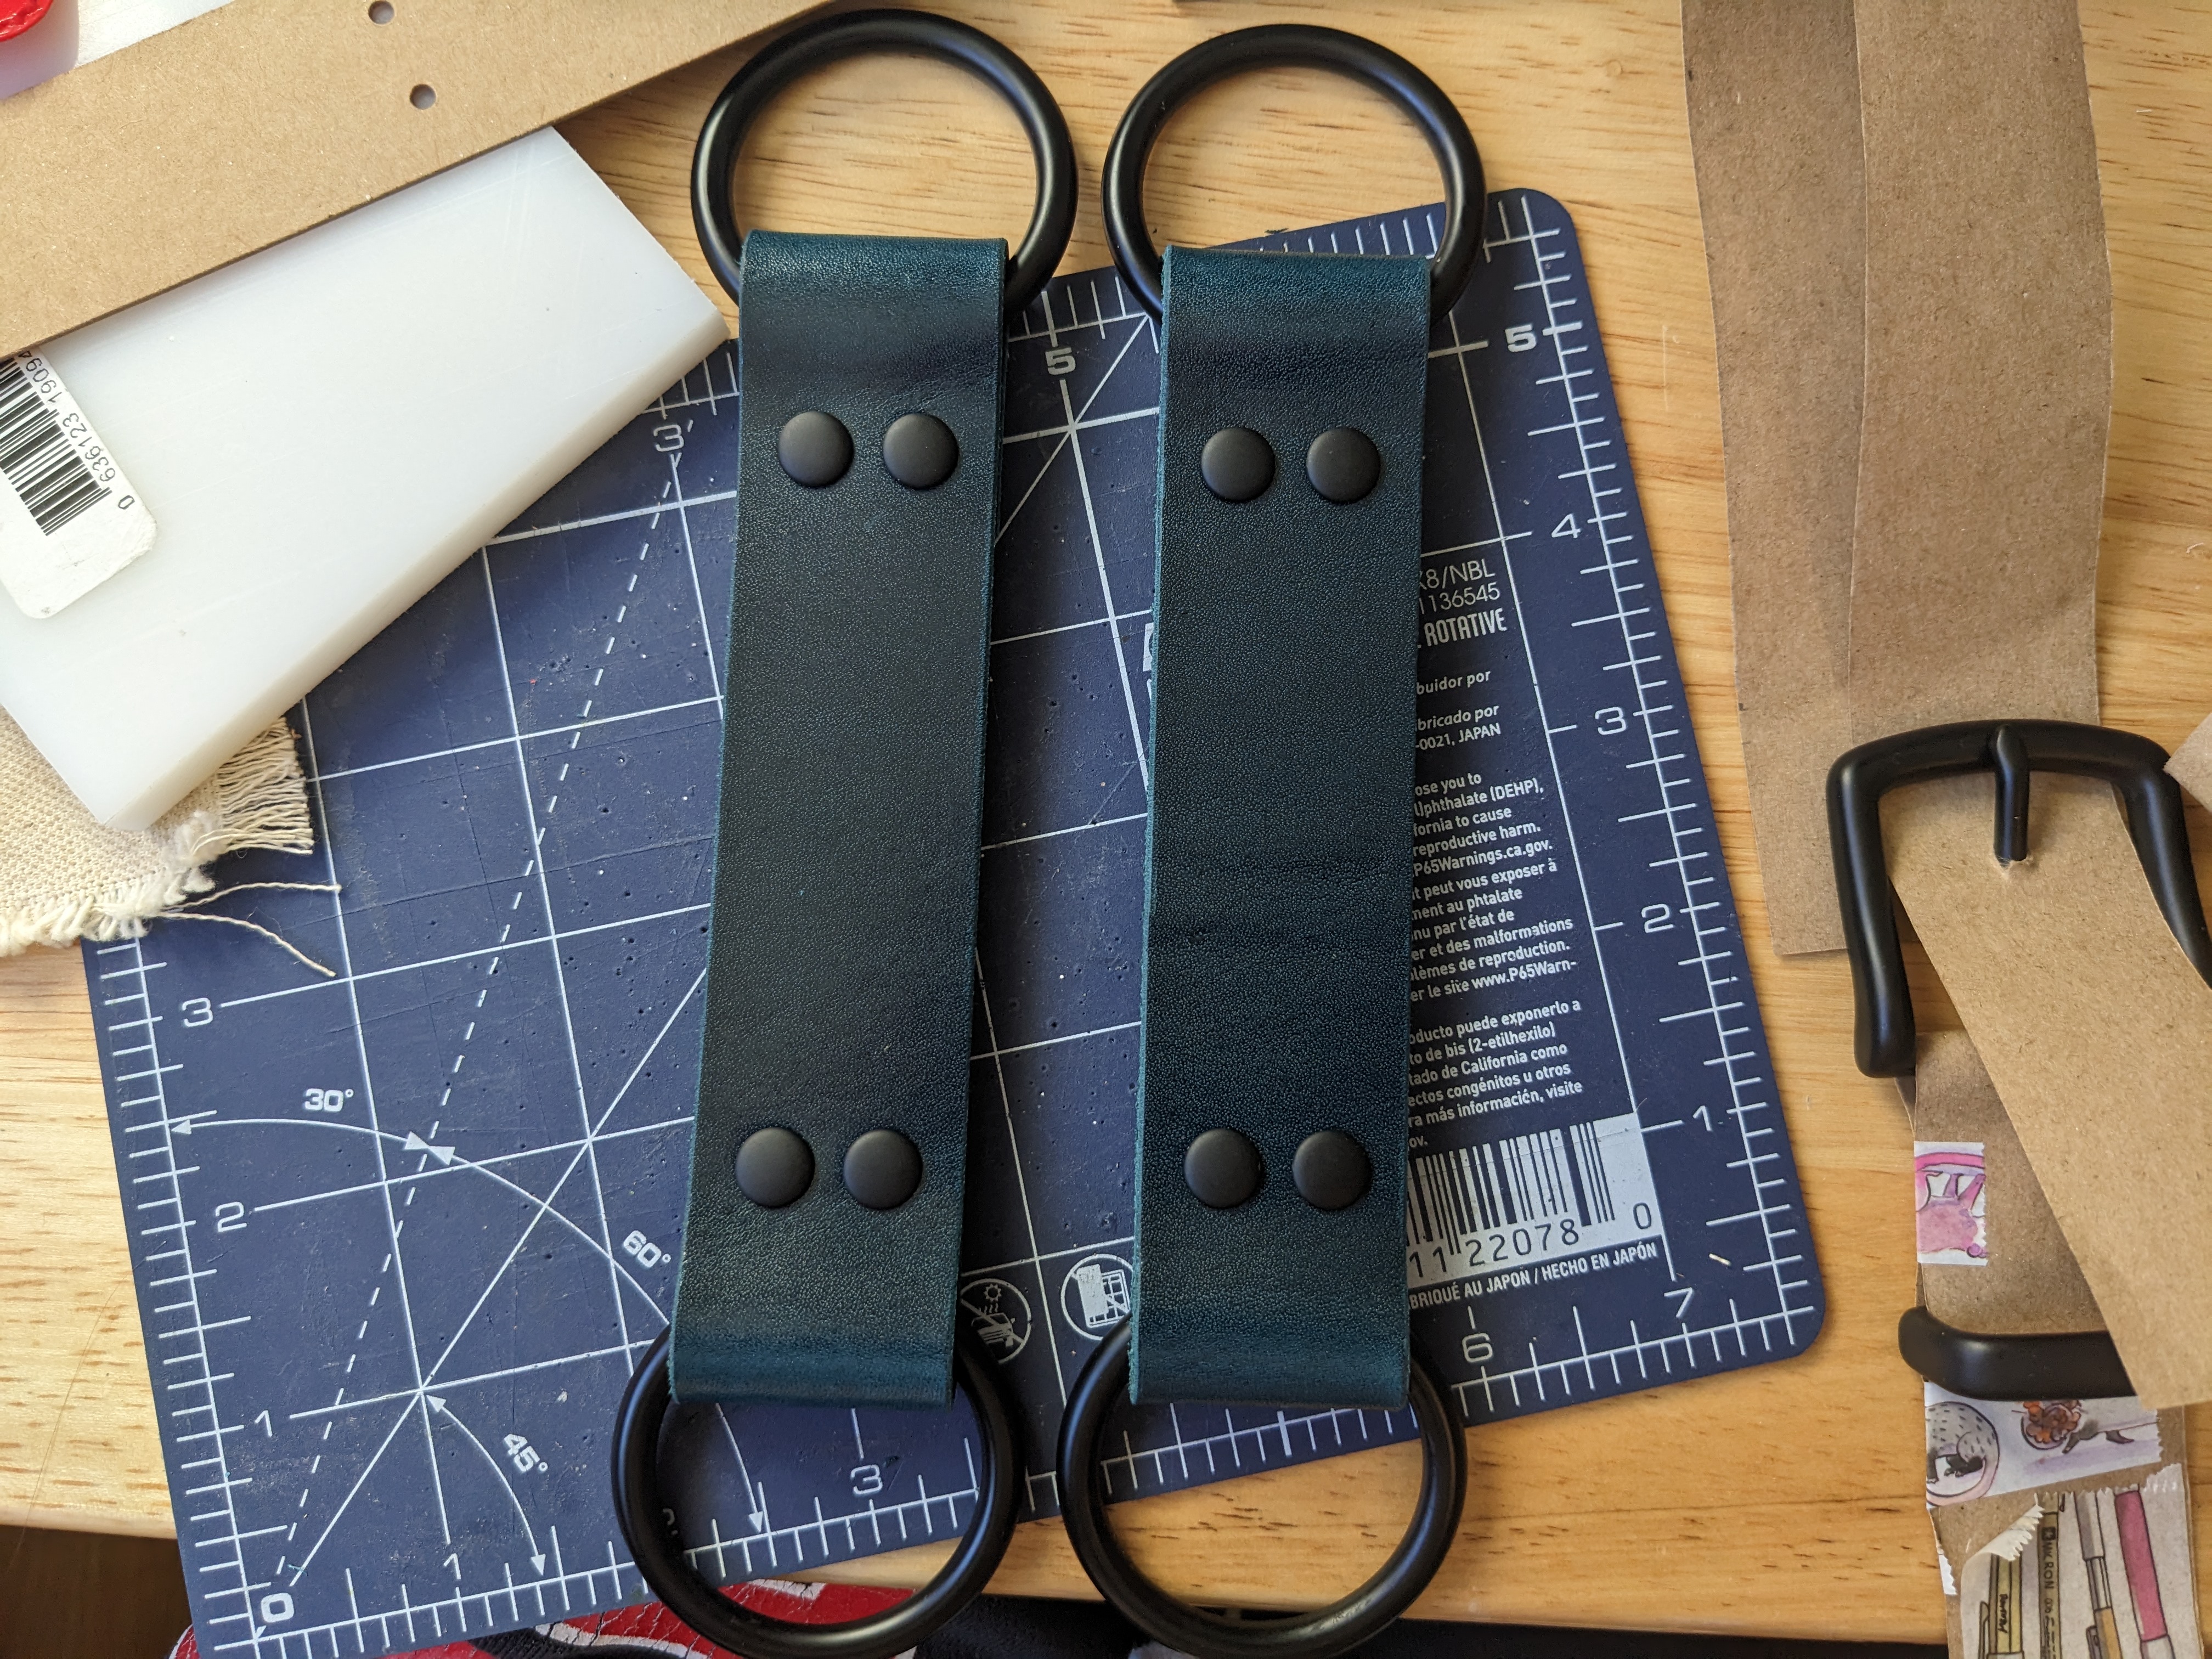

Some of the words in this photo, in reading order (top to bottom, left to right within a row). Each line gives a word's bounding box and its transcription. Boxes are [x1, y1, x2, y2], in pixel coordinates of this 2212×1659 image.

[1505, 325, 1537, 352] 5
[1045, 347, 1076, 375] 5
[63, 413, 116, 482] 636123
[1551, 514, 1581, 538] 4
[1424, 608, 1508, 646] ROTATIVE
[1467, 671, 1491, 687] por
[1415, 710, 1471, 731] bricado
[1475, 706, 1499, 723] por
[1459, 723, 1502, 742] JAPAN
[1595, 707, 1627, 736] 3
[1415, 783, 1438, 795] ose
[1441, 777, 1465, 794] you
[1468, 773, 1481, 785] to
[1490, 777, 1544, 801] (DEHP),
[1455, 816, 1469, 827] to
[1472, 808, 1512, 824] cause
[1413, 830, 1497, 857] reproductive
[1499, 823, 1541, 839] harm.
[1424, 881, 1454, 901] peut
[1456, 876, 1488, 890] vous
[1491, 864, 1545, 884] exposer
[1447, 901, 1464, 913] au
[1466, 888, 1522, 912] phtalate
[1412, 928, 1431, 940] nu
[1434, 922, 1457, 939] par
[1459, 912, 1496, 930] l'état
[1498, 909, 1514, 923] de
[1641, 903, 1675, 933] 2
[1430, 943, 1443, 957] et
[1446, 940, 1471, 953] des
[1474, 919, 1573, 948] malformations
[1459, 957, 1476, 971] de
[1479, 940, 1571, 968] reproduction.
[1427, 985, 1441, 997] le
[1444, 980, 1469, 994] site
[1471, 960, 1577, 989] www.P65Warn-
[182, 997, 213, 1028] 3
[1456, 1015, 1498, 1038] puede
[1502, 1001, 1570, 1026] exponerlo
[1572, 1000, 1582, 1011] a
[1426, 1047, 1442, 1061] de
[1444, 1042, 1466, 1057] bis
[1468, 1021, 1555, 1054] (2-etilhexilo)
[1442, 1065, 1458, 1079] de
[1461, 1050, 1528, 1075] California
[1531, 1044, 1568, 1060] como
[303, 1088, 354, 1112] 30°
[1408, 1090, 1443, 1106] ectos
[1447, 1075, 1521, 1098] congénitos
[1523, 1072, 1533, 1083] u
[1536, 1064, 1572, 1080] otros
[1426, 1106, 1455, 1124] más
[1457, 1088, 1544, 1117] información,
[1545, 1081, 1583, 1098] visite
[1693, 1105, 1713, 1131] 1
[215, 1201, 247, 1233] 2
[1633, 1203, 1652, 1229] 0
[623, 1230, 672, 1268] 60°
[1464, 1280, 1483, 1298] AU
[1542, 1259, 1588, 1282] HECHO
[1591, 1251, 1610, 1269] EN
[1612, 1241, 1658, 1265] JAPÓN
[1664, 1287, 1694, 1318] 7
[1462, 1333, 1493, 1363] 6
[255, 1410, 273, 1437] 1
[503, 1433, 549, 1472] 45°
[851, 1464, 883, 1494] 3
[443, 1554, 461, 1579] 1
[261, 1593, 295, 1623] 0
